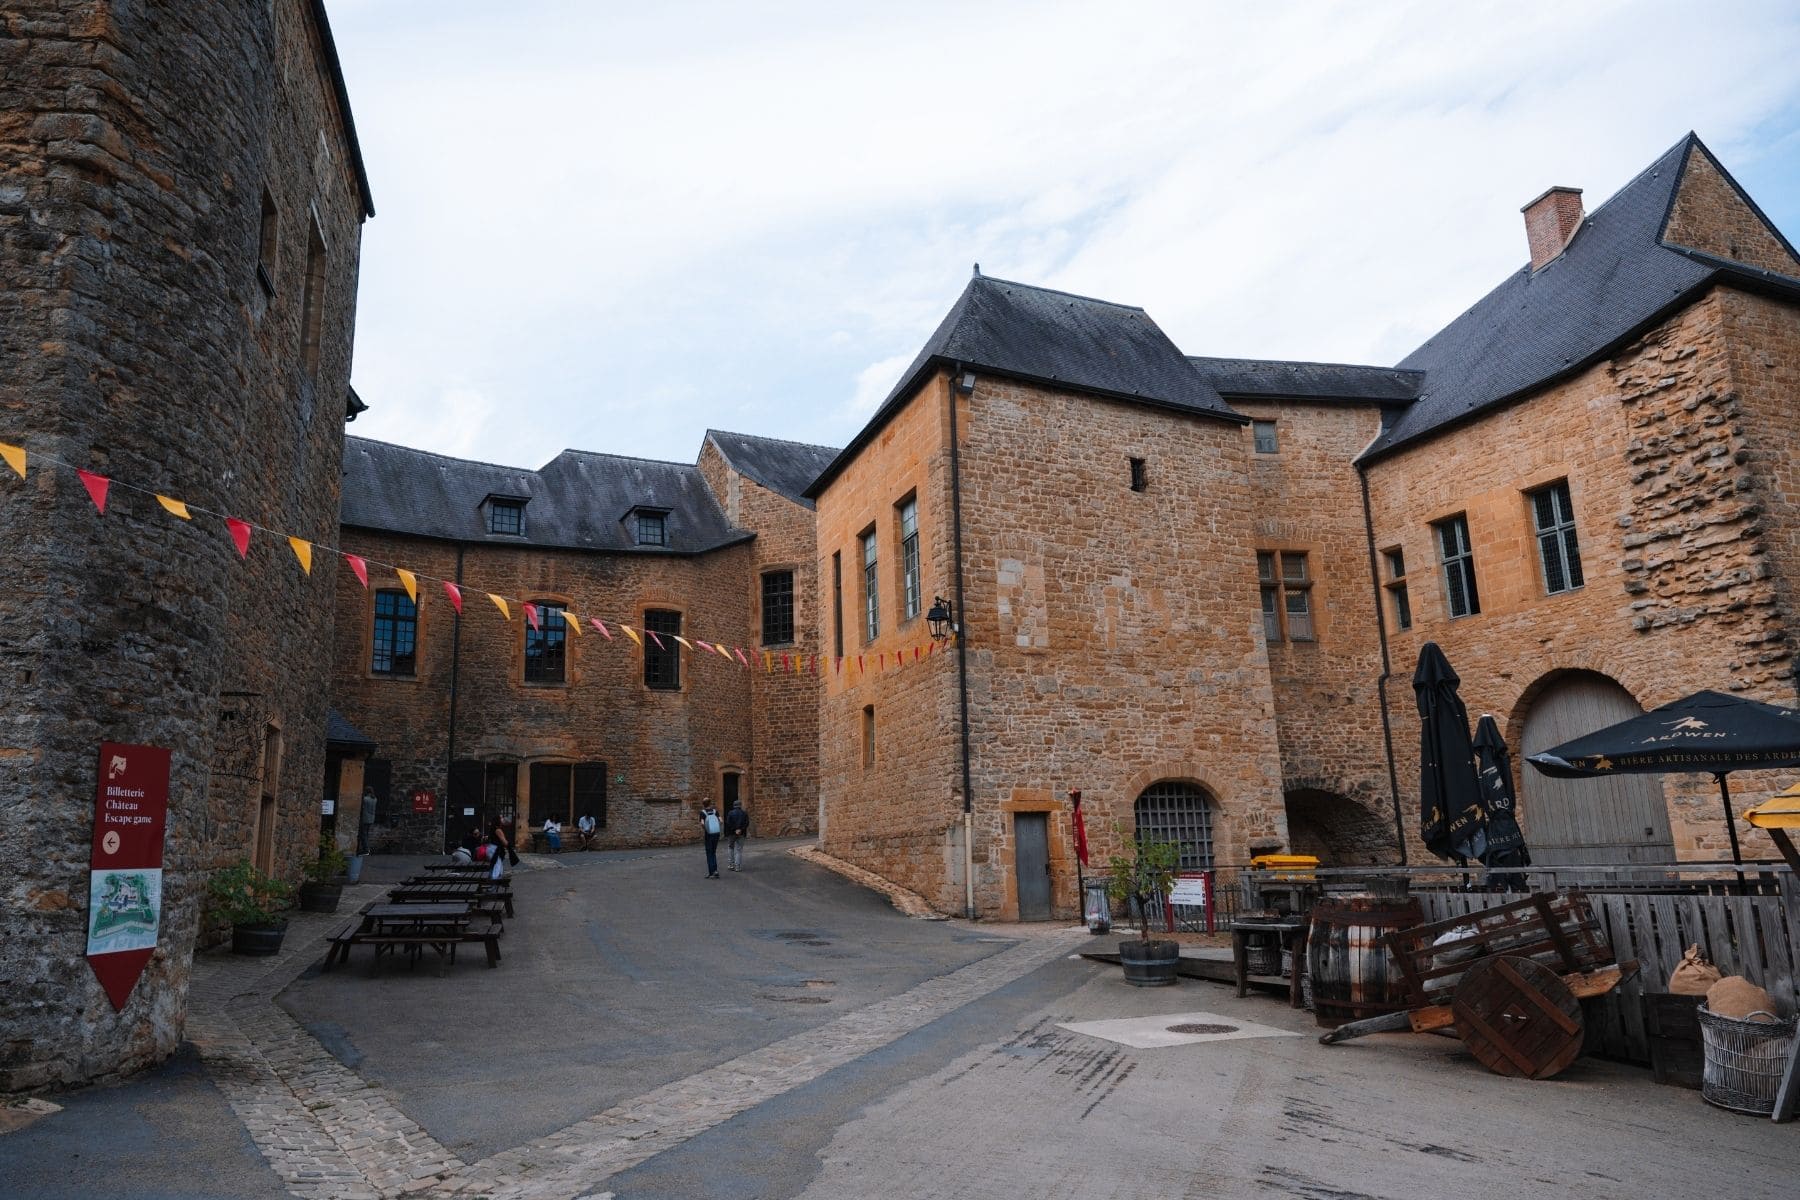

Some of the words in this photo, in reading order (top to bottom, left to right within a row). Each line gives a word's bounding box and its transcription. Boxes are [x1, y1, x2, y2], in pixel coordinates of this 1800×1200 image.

[1641, 731, 1727, 744] ARDWEN
[1658, 753, 1732, 764] ARTISANALE
[1735, 752, 1760, 761] DES
[106, 786, 145, 798] Billetterie
[106, 799, 139, 810] Château
[105, 812, 133, 825] Escape
[133, 815, 153, 826] game
